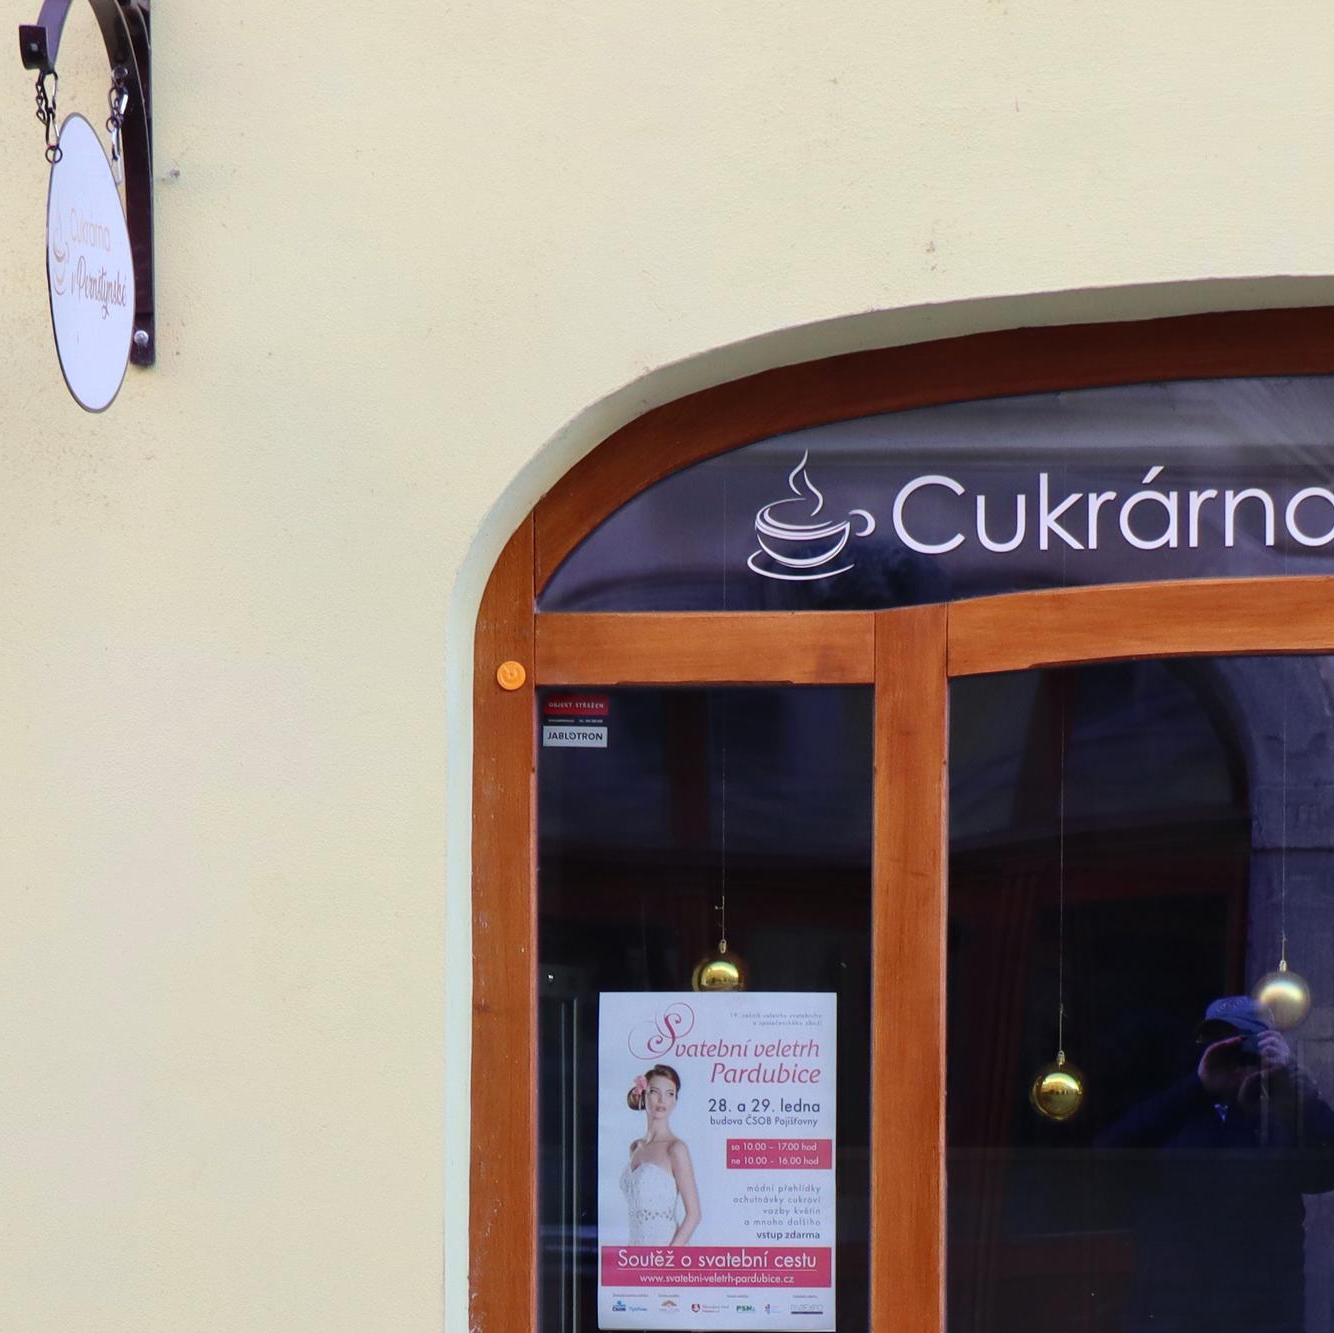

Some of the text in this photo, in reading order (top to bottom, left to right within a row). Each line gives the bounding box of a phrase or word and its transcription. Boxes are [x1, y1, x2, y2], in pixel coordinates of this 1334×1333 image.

[547, 731, 603, 740] JABLOTRON
[628, 1002, 819, 1060] Svatební veletrh
[710, 1062, 821, 1083] Pardubice
[708, 1098, 820, 1113] 28. a 29. ledna
[710, 1116, 743, 1126] budova
[746, 1114, 772, 1126] ČSOB
[743, 1143, 766, 1151] 10.00
[801, 1142, 817, 1151] hod
[744, 1157, 767, 1165] 10.00
[803, 1156, 819, 1165] hod
[756, 1230, 820, 1241] vstup zdarma
[618, 1249, 817, 1268] Soutěž o svatební cestu
